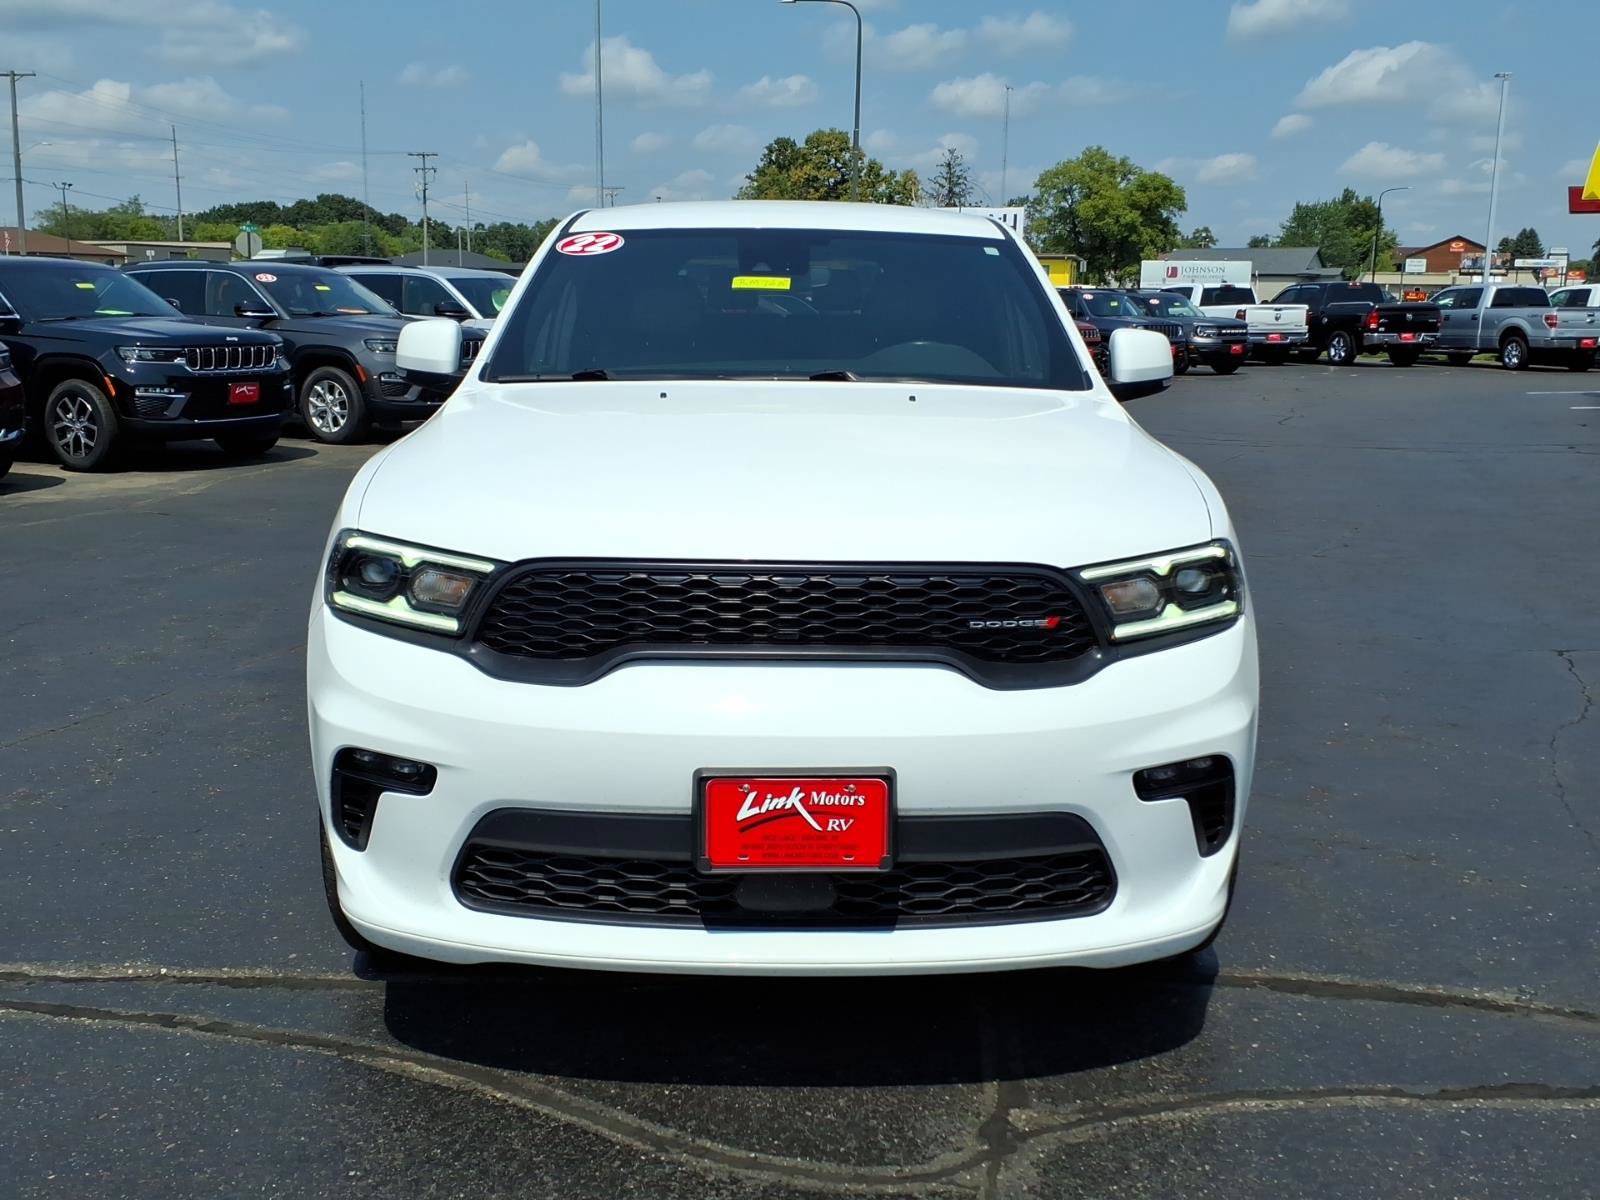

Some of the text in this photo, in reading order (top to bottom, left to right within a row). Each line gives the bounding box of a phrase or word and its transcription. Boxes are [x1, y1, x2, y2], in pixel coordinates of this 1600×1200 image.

[561, 235, 618, 252] 22
[1181, 266, 1226, 275] JOHNSON
[969, 619, 1048, 628] DODGE
[736, 787, 865, 831] Link Motors
[828, 818, 855, 831] RV
